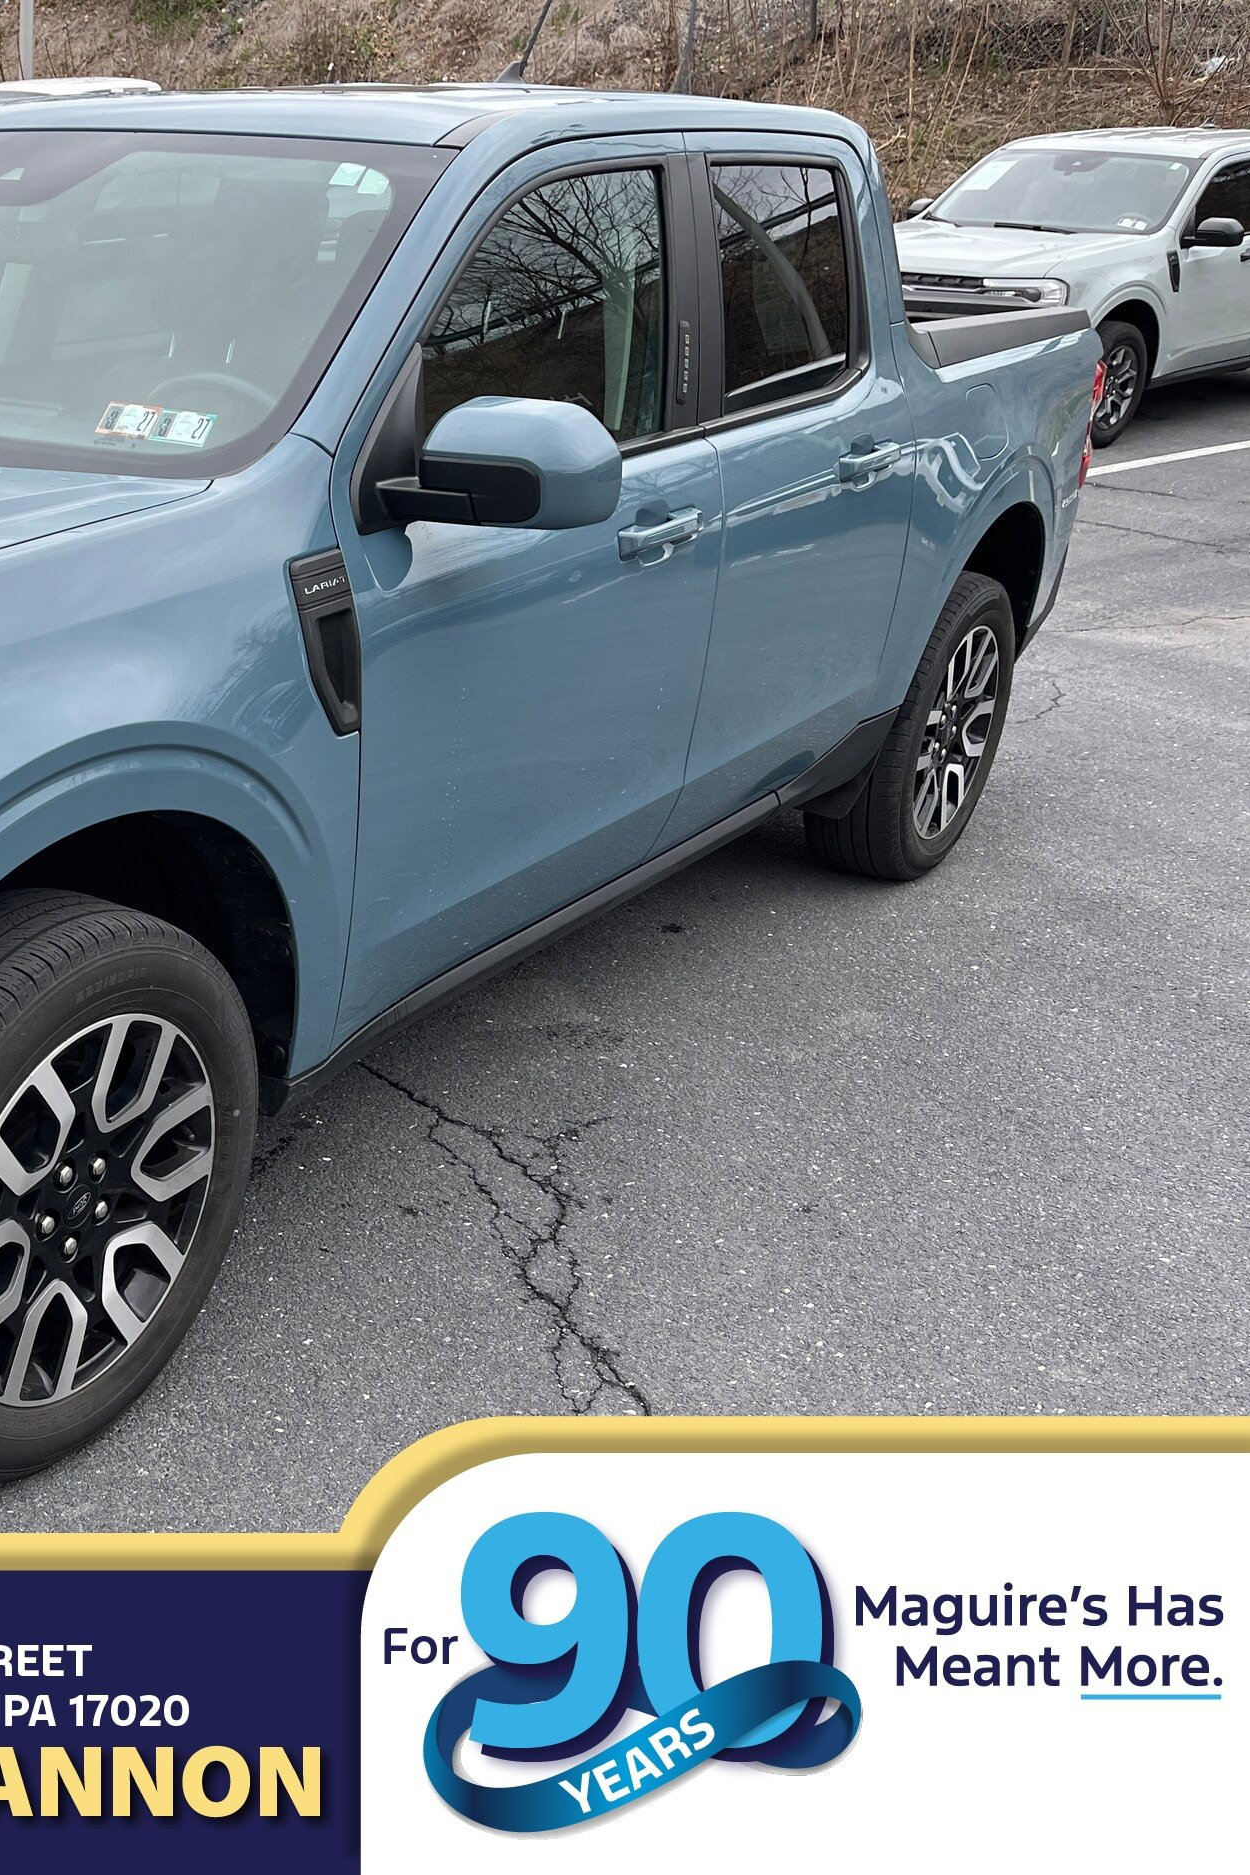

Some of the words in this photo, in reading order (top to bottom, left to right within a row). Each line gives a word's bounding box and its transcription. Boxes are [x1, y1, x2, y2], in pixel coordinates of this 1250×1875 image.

[104, 410, 119, 430] 3
[136, 410, 156, 432] 27
[158, 417, 172, 437] 3
[190, 417, 211, 439] 27
[304, 575, 346, 595] LARIAT
